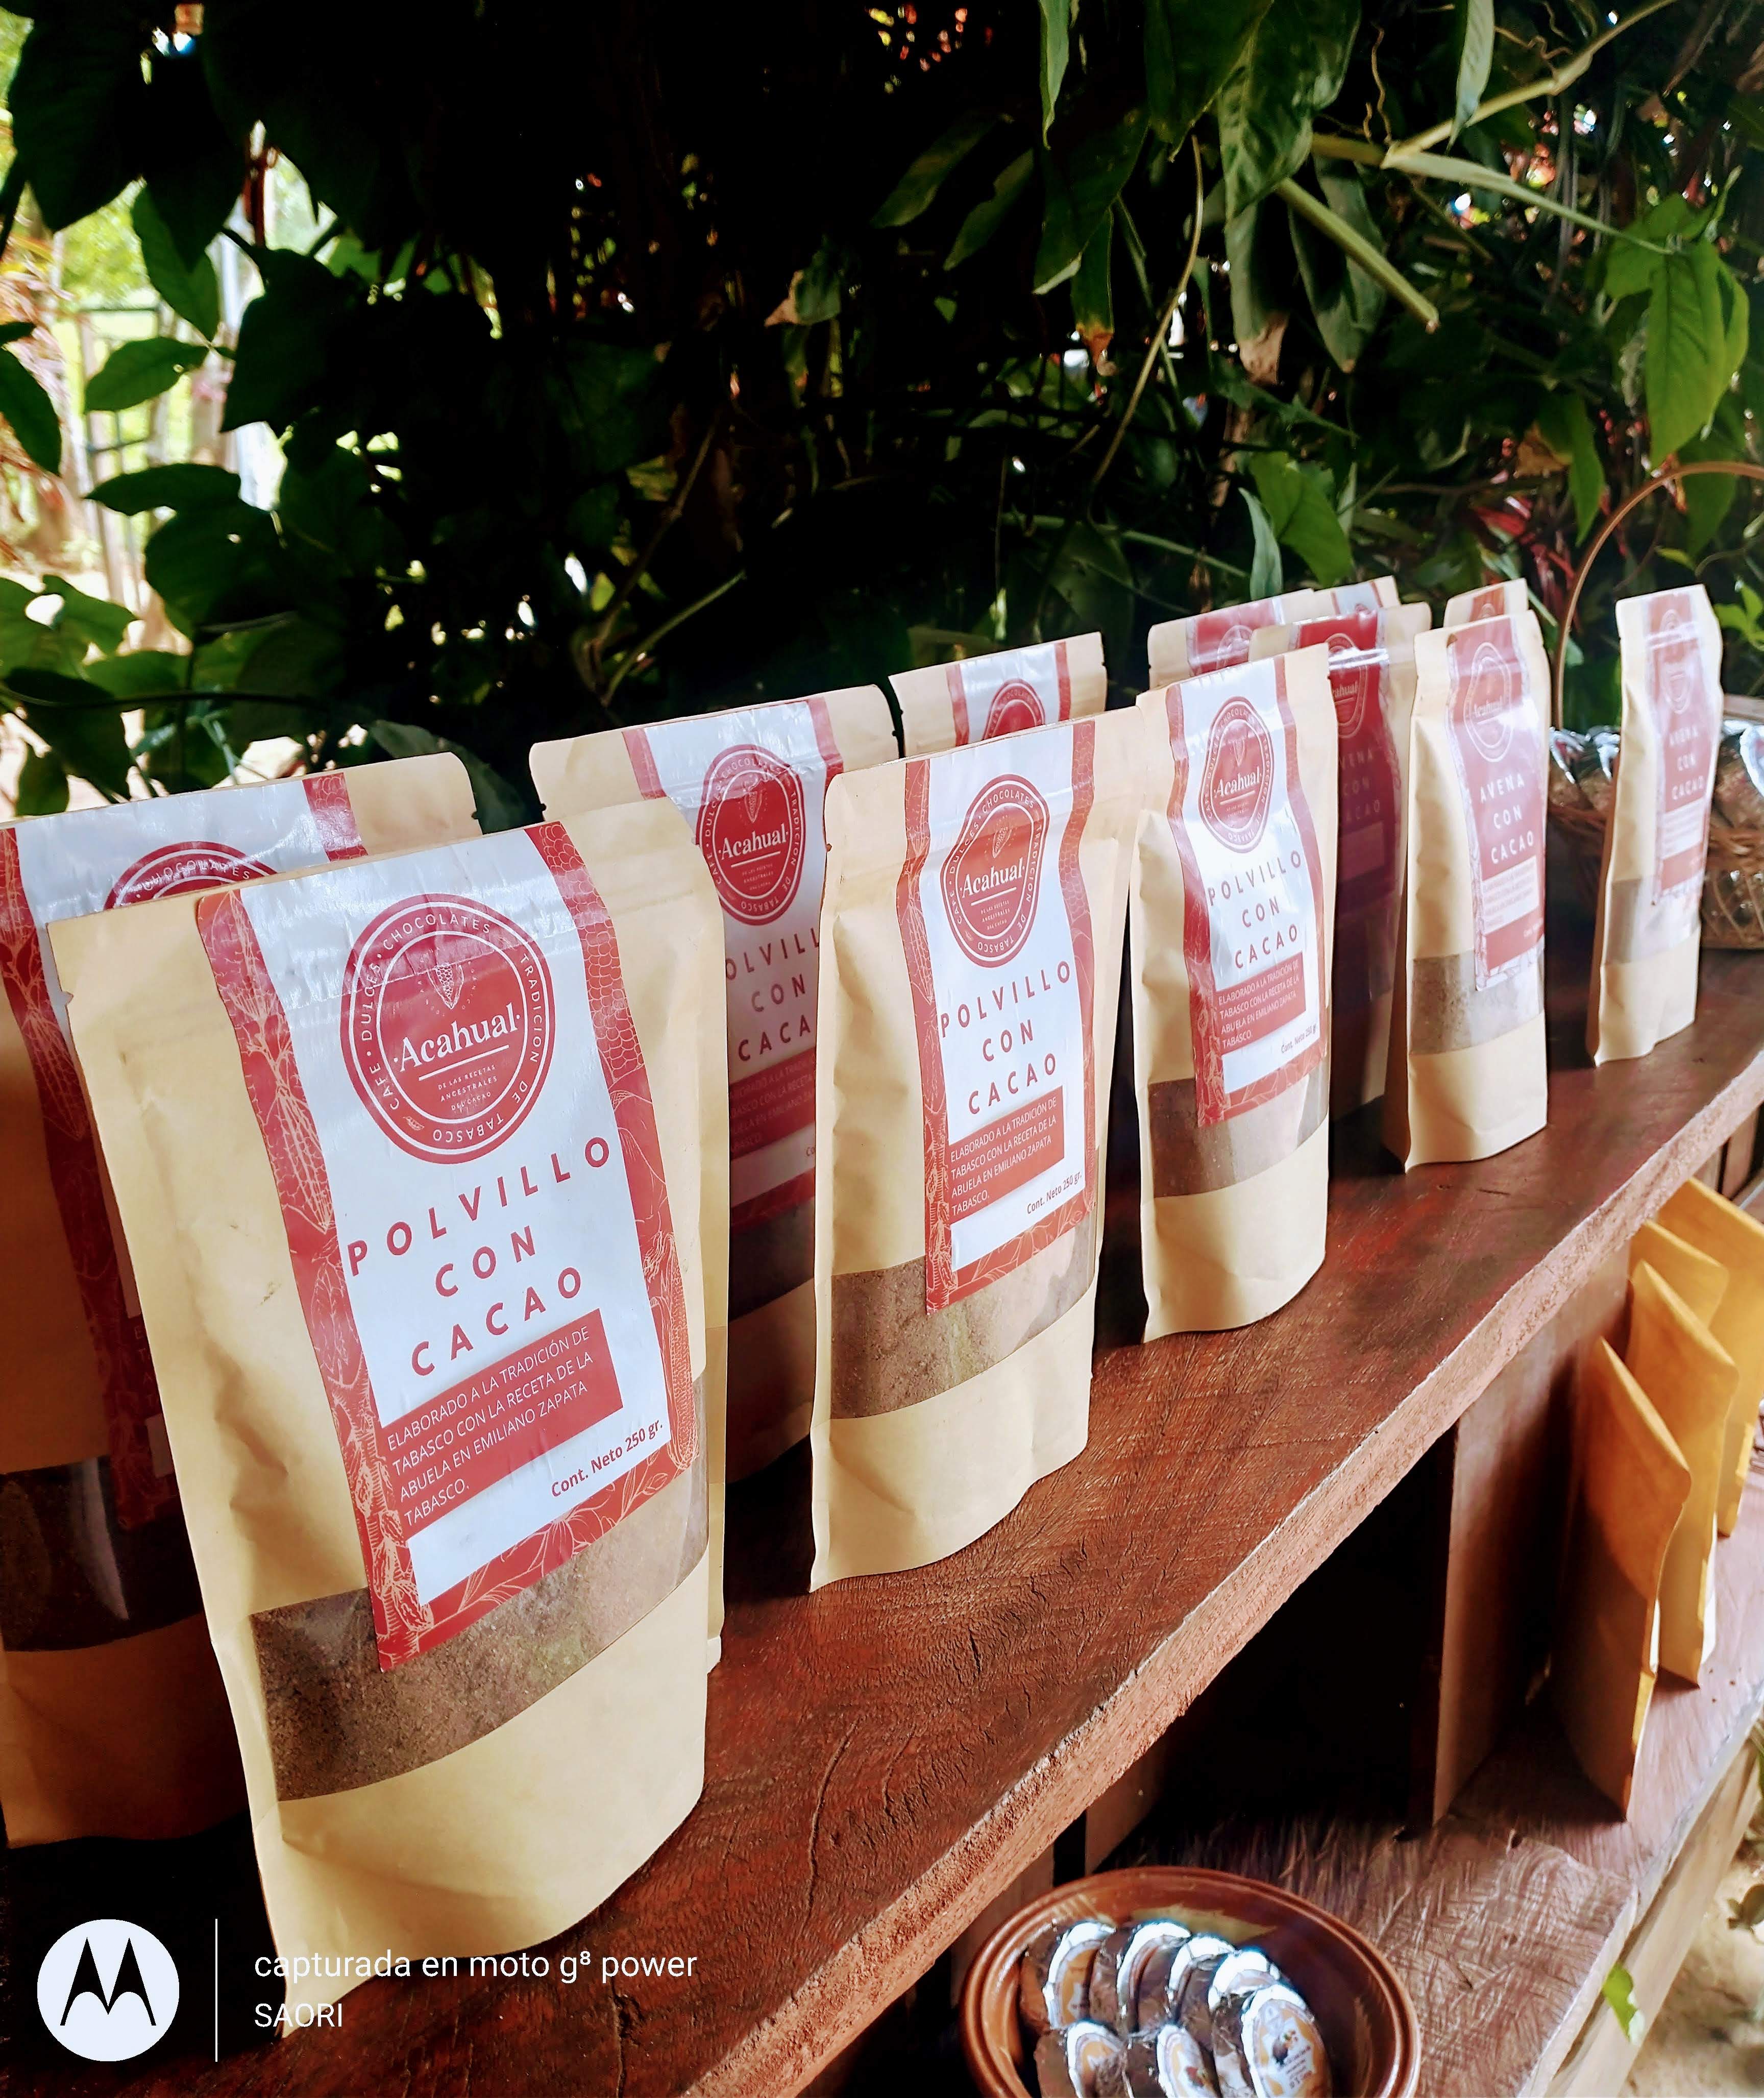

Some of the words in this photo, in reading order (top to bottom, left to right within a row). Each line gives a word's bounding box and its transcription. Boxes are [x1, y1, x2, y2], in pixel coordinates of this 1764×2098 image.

[1333, 680, 1360, 698] ahual
[1339, 748, 1374, 770] VENA
[982, 789, 1034, 814] CHOCOLATES
[1215, 766, 1261, 798] Acahual
[1480, 773, 1525, 803] AVENA
[1345, 799, 1381, 822] ACAO
[1492, 804, 1523, 831] CON
[721, 823, 787, 860] Acahual
[948, 822, 981, 874] DULCES
[1491, 830, 1534, 865] CACAO
[962, 857, 1023, 898] Acahual
[1025, 824, 1042, 903] TRADICION
[1208, 850, 1301, 906] POLVILLO
[948, 891, 962, 924] CAFE
[1017, 914, 1026, 931] DE
[1242, 896, 1280, 928] CON
[382, 913, 491, 950] CHOCOLATES
[977, 934, 1015, 953] TABASCO
[1235, 923, 1297, 969] CACAO
[725, 928, 820, 981] OLVILL
[360, 962, 381, 1041] DULCES
[519, 952, 543, 1064] TRADICION
[751, 974, 806, 1012] CON
[940, 961, 1070, 1038] POLVILLO
[1218, 982, 1256, 1006] ELABORADO
[1219, 1000, 1250, 1020] TABASCO
[1249, 994, 1262, 1008] CON
[1262, 990, 1269, 1002] LA
[1268, 982, 1286, 999] RECETA
[399, 1002, 520, 1072] Acahual
[738, 1014, 811, 1061] CACA
[982, 1019, 1034, 1062] CON
[1221, 1017, 1246, 1035] ABUELA
[1247, 1013, 1255, 1024] EN
[368, 1062, 401, 1111] CAFE
[438, 1082, 447, 1090] DE
[449, 1077, 462, 1086] LAS
[464, 1064, 496, 1080] RECETAS
[440, 1076, 498, 1103] ANCESTRALES
[511, 1080, 529, 1105] DE
[968, 1053, 1056, 1114] CACAO
[432, 1112, 505, 1143] TABASCO
[951, 1130, 995, 1162] ELABORADO
[996, 1128, 1002, 1137] A
[1002, 1124, 1012, 1135] LA
[1011, 1103, 1047, 1130] TRADICIÓN
[1048, 1096, 1057, 1110] DE
[951, 1154, 986, 1180] TABASCO
[987, 1147, 1003, 1161] CON
[1004, 1140, 1013, 1152] LA
[1013, 1126, 1038, 1147] RECETA
[1038, 1119, 1047, 1131] DE
[1048, 1115, 1057, 1127] LA
[951, 1175, 983, 1199] ABUELA
[983, 1167, 993, 1182] EN
[994, 1149, 1027, 1176] EMILIANO
[1027, 1135, 1052, 1157] ZAPATA
[348, 1136, 610, 1277] POLVILLO
[951, 1190, 990, 1216] TABASCO.
[1027, 1198, 1045, 1214] Cont.
[1046, 1185, 1062, 1202] Neto
[1063, 1177, 1073, 1190] 250
[434, 1225, 536, 1298] CON
[411, 1266, 582, 1377] CACAO
[387, 1393, 468, 1451] ELABORADO
[471, 1387, 481, 1403] A
[481, 1376, 500, 1395] LA
[499, 1337, 570, 1384] TRADICIÓN
[572, 1326, 590, 1346] DE
[392, 1428, 454, 1476] TABASCO
[456, 1408, 487, 1438] CON
[487, 1400, 505, 1419] LA
[506, 1372, 556, 1408] RECETA
[556, 1360, 575, 1381] DE
[576, 1351, 594, 1370] LA
[399, 1460, 452, 1503] ABUELA
[452, 1446, 472, 1467] EN
[473, 1408, 535, 1455] EMILIANO
[537, 1380, 588, 1418] ZAPATA
[551, 1469, 589, 1497] Cont.
[590, 1446, 623, 1474] Neto
[625, 1429, 646, 1452] 250
[648, 1420, 663, 1440] gr.
[404, 1478, 471, 1527] TABASCO.
